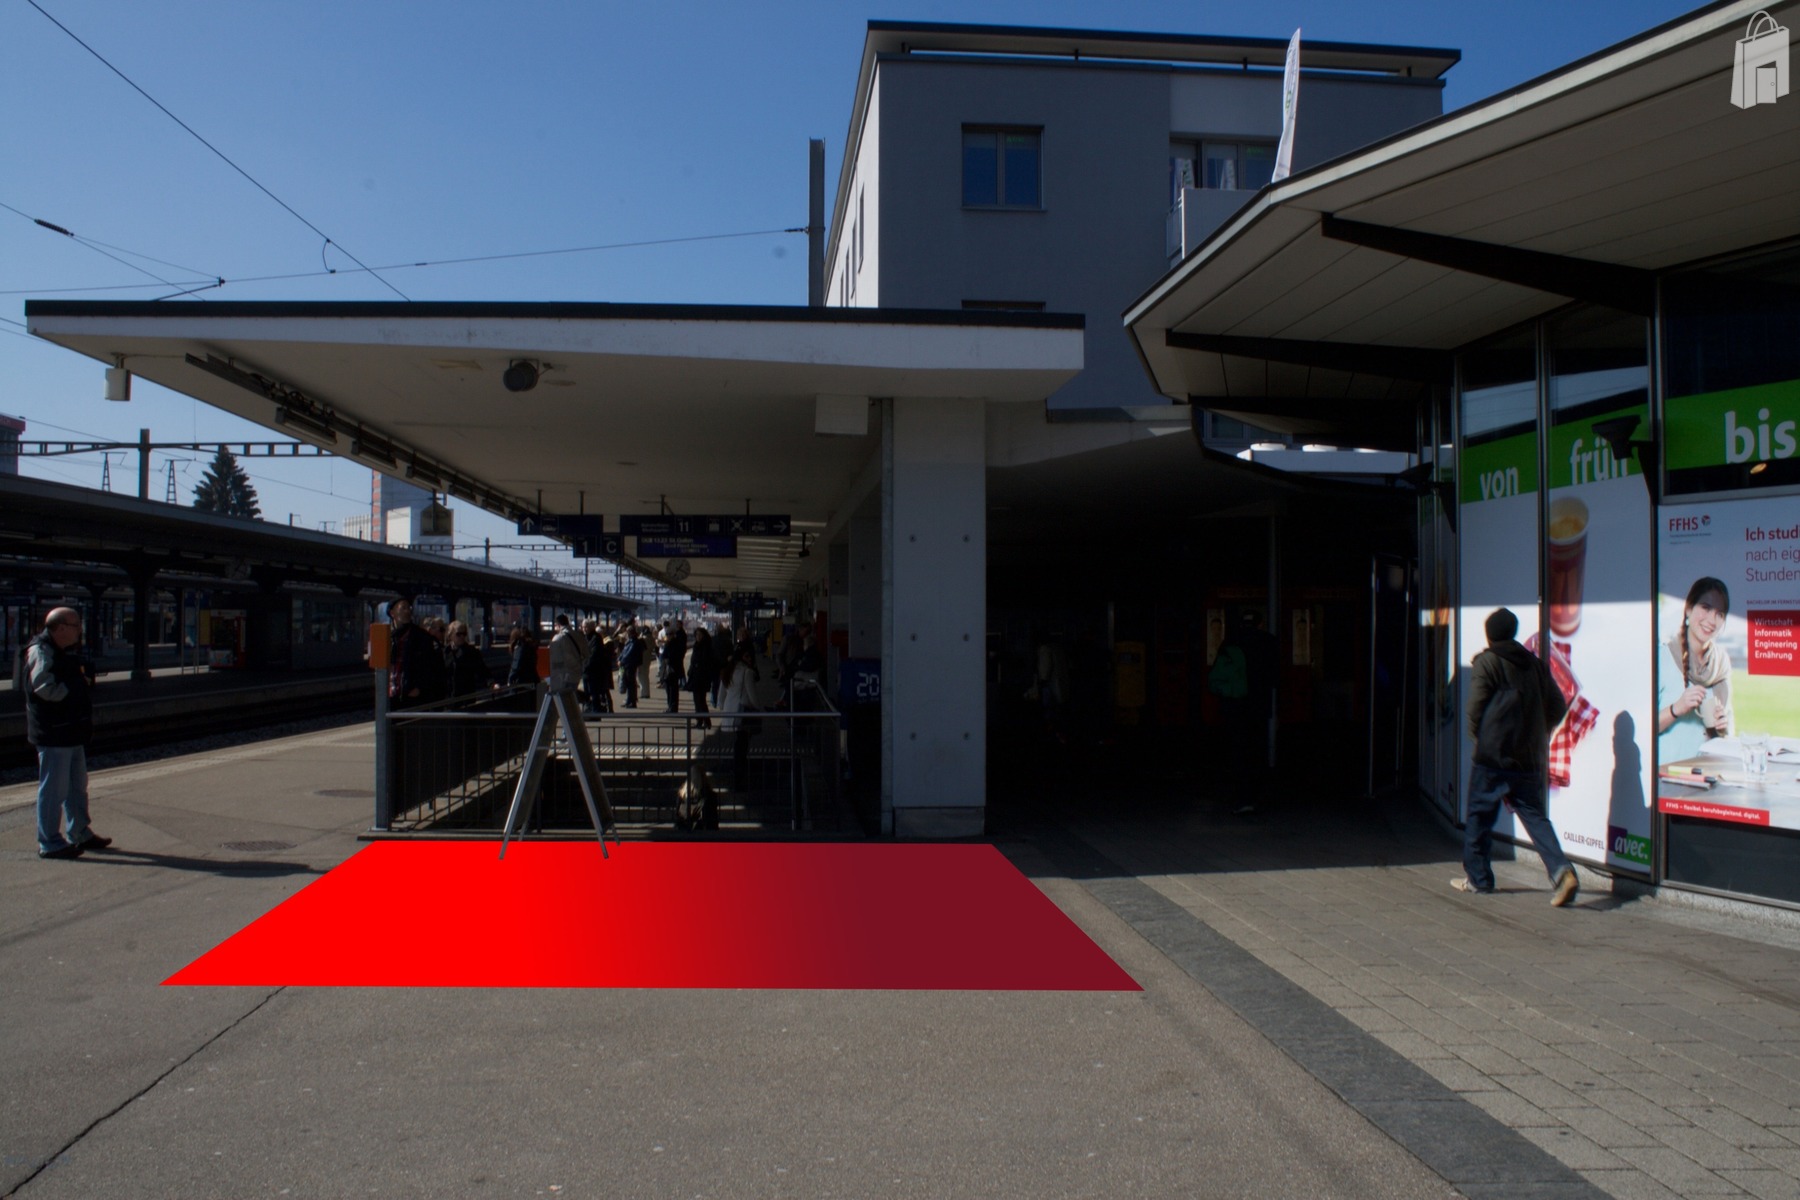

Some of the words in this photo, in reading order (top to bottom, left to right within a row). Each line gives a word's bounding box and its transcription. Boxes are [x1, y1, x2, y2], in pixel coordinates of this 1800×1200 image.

[1480, 467, 1518, 500] von
[1725, 408, 1796, 464] bis
[679, 521, 689, 532] 11
[1669, 517, 1699, 531] FFHS
[1746, 527, 1765, 541] Ich
[582, 541, 588, 554] 1
[606, 541, 617, 554] C
[1746, 546, 1777, 561] nach
[1781, 545, 1800, 563] eig
[1746, 566, 1800, 582] Stunden
[1755, 618, 1793, 626] Wirtschaft
[1755, 629, 1793, 637] Informatik
[1755, 639, 1798, 650] Engineering
[1755, 650, 1793, 661] Ernährung
[857, 672, 880, 697] 20
